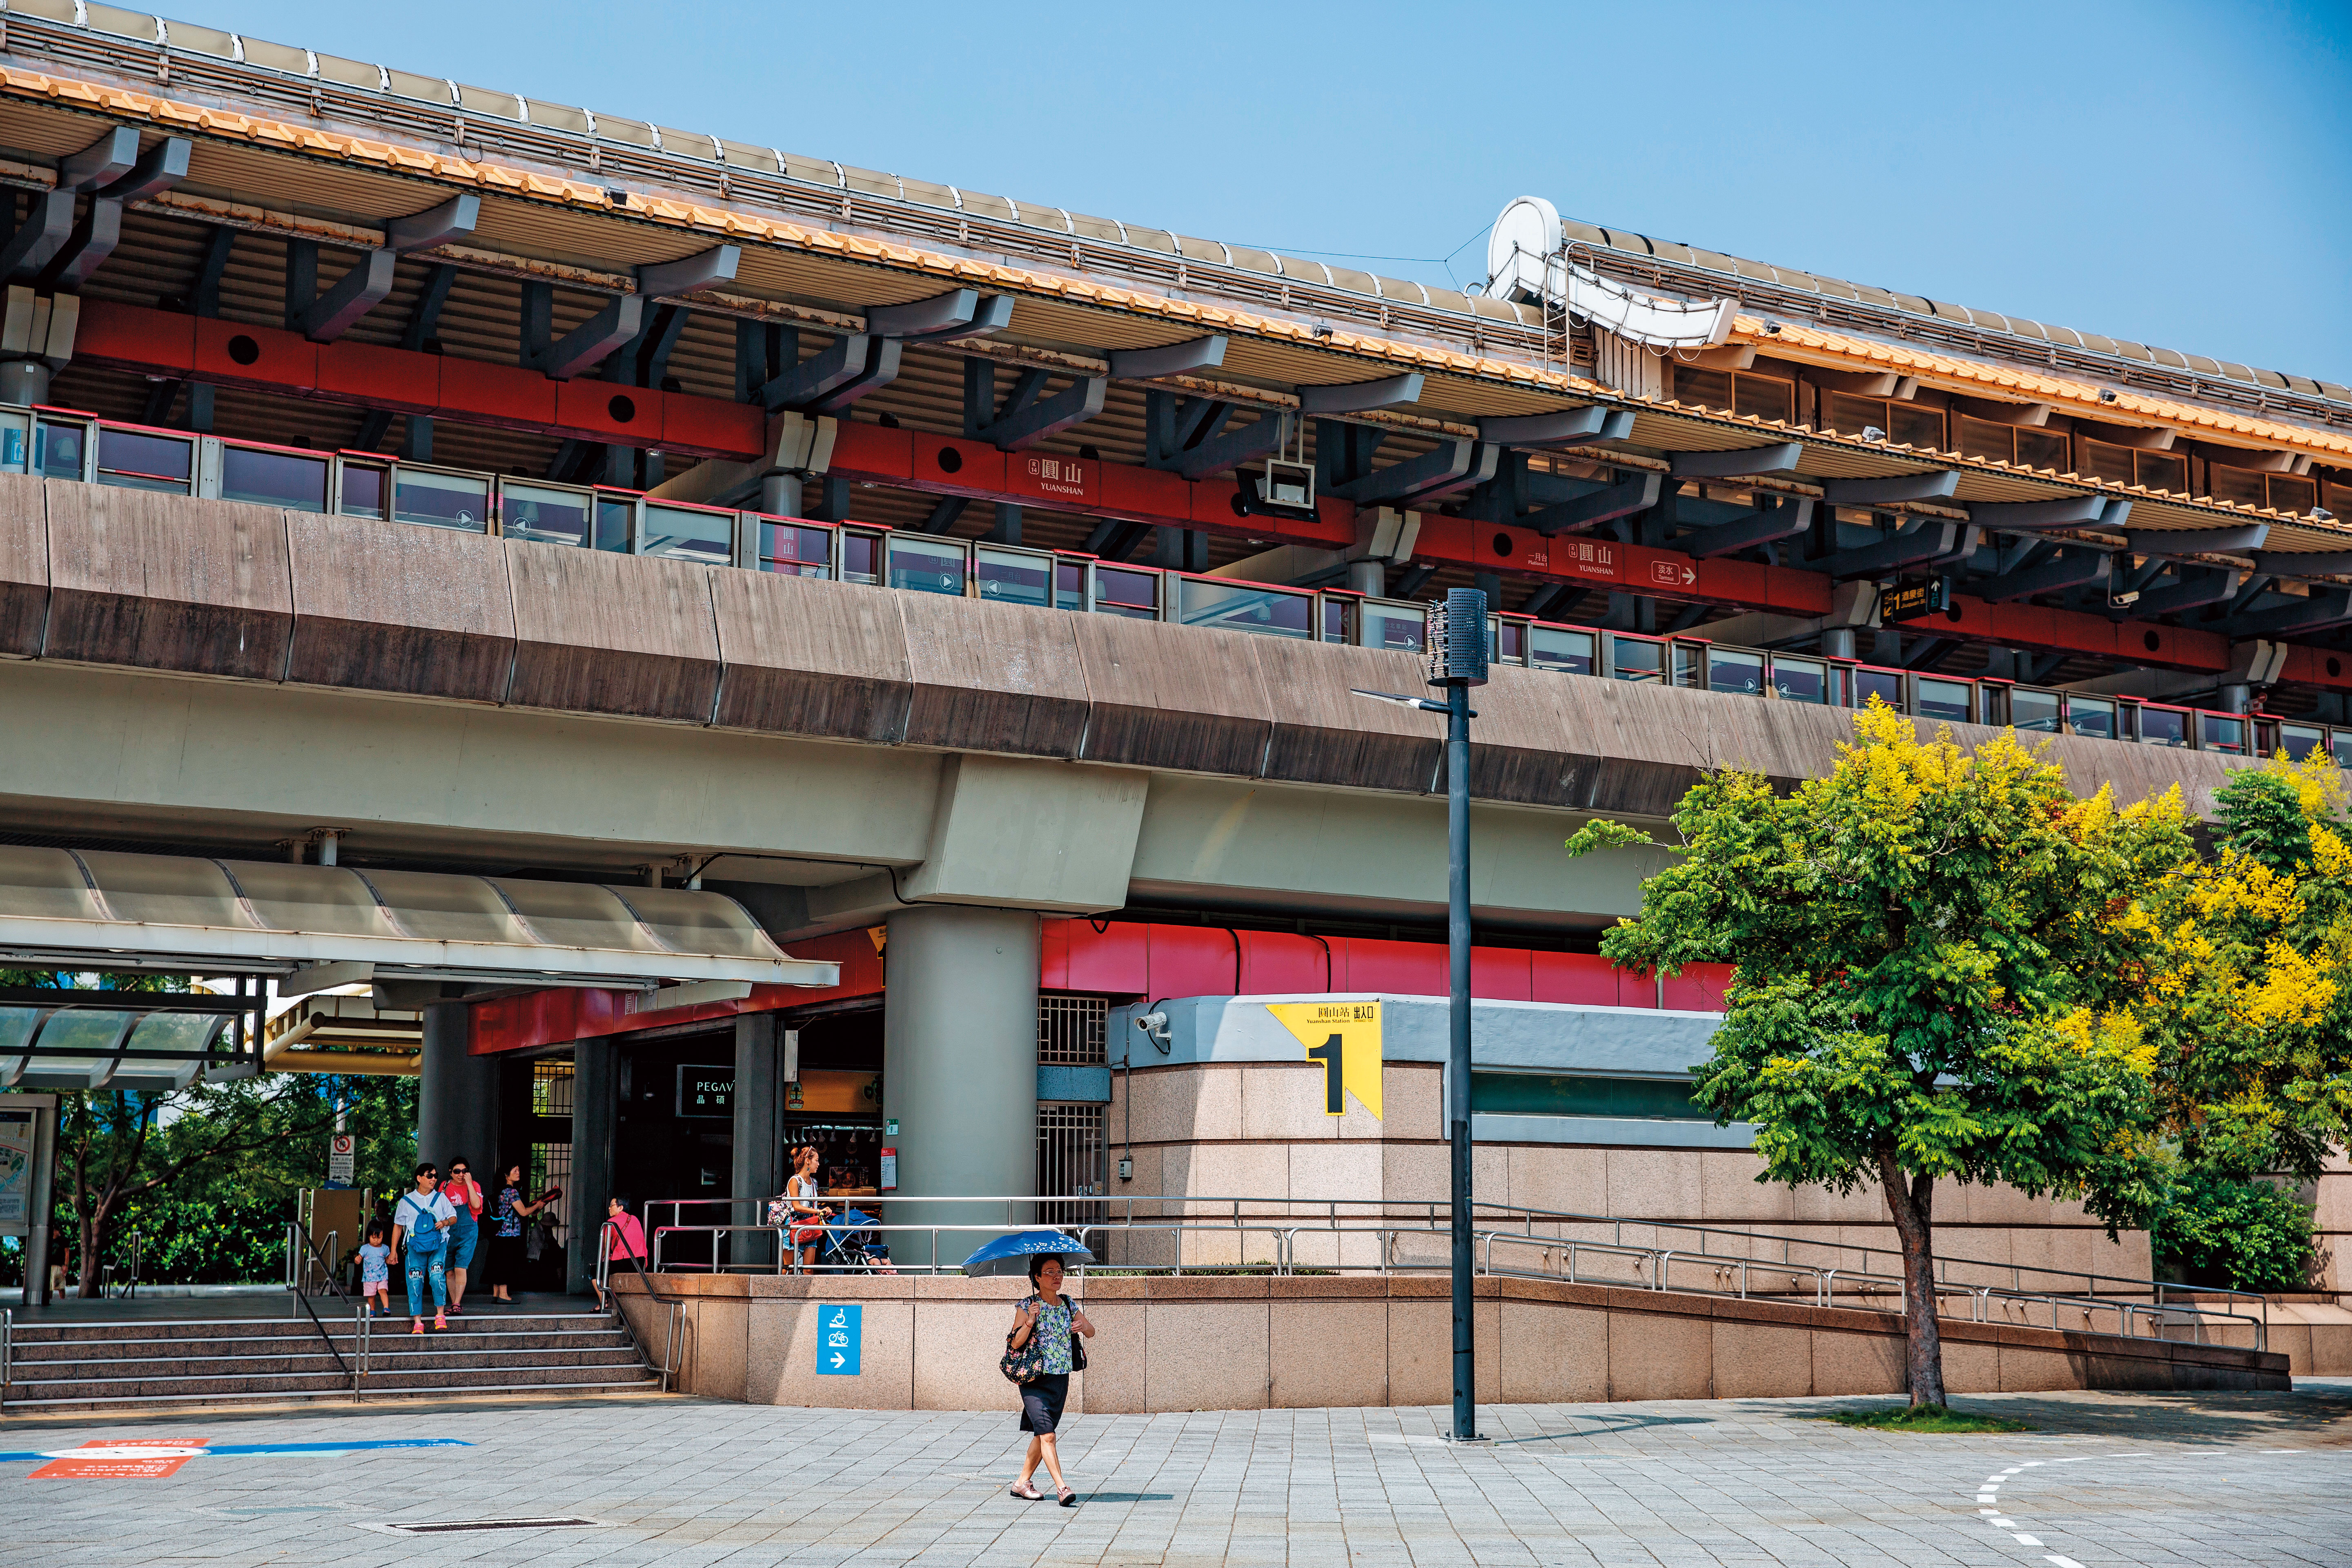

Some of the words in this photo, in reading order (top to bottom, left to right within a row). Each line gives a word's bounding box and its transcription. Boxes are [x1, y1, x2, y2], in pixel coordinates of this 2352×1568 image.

[1042, 459, 1081, 483] 圓山
[1041, 482, 1083, 496] YUANSHAN
[784, 528, 794, 555] 圓山
[1528, 552, 1548, 562] 一月台
[1579, 543, 1611, 565] 圓山
[1579, 564, 1613, 575] YUANSHAN
[1658, 565, 1673, 575] 淡水
[1893, 593, 1900, 610] 1
[1319, 1007, 1350, 1018] 圓山站
[1354, 1006, 1373, 1019] 出入口
[1309, 1033, 1342, 1113] 1
[697, 1080, 735, 1092] PEGAV
